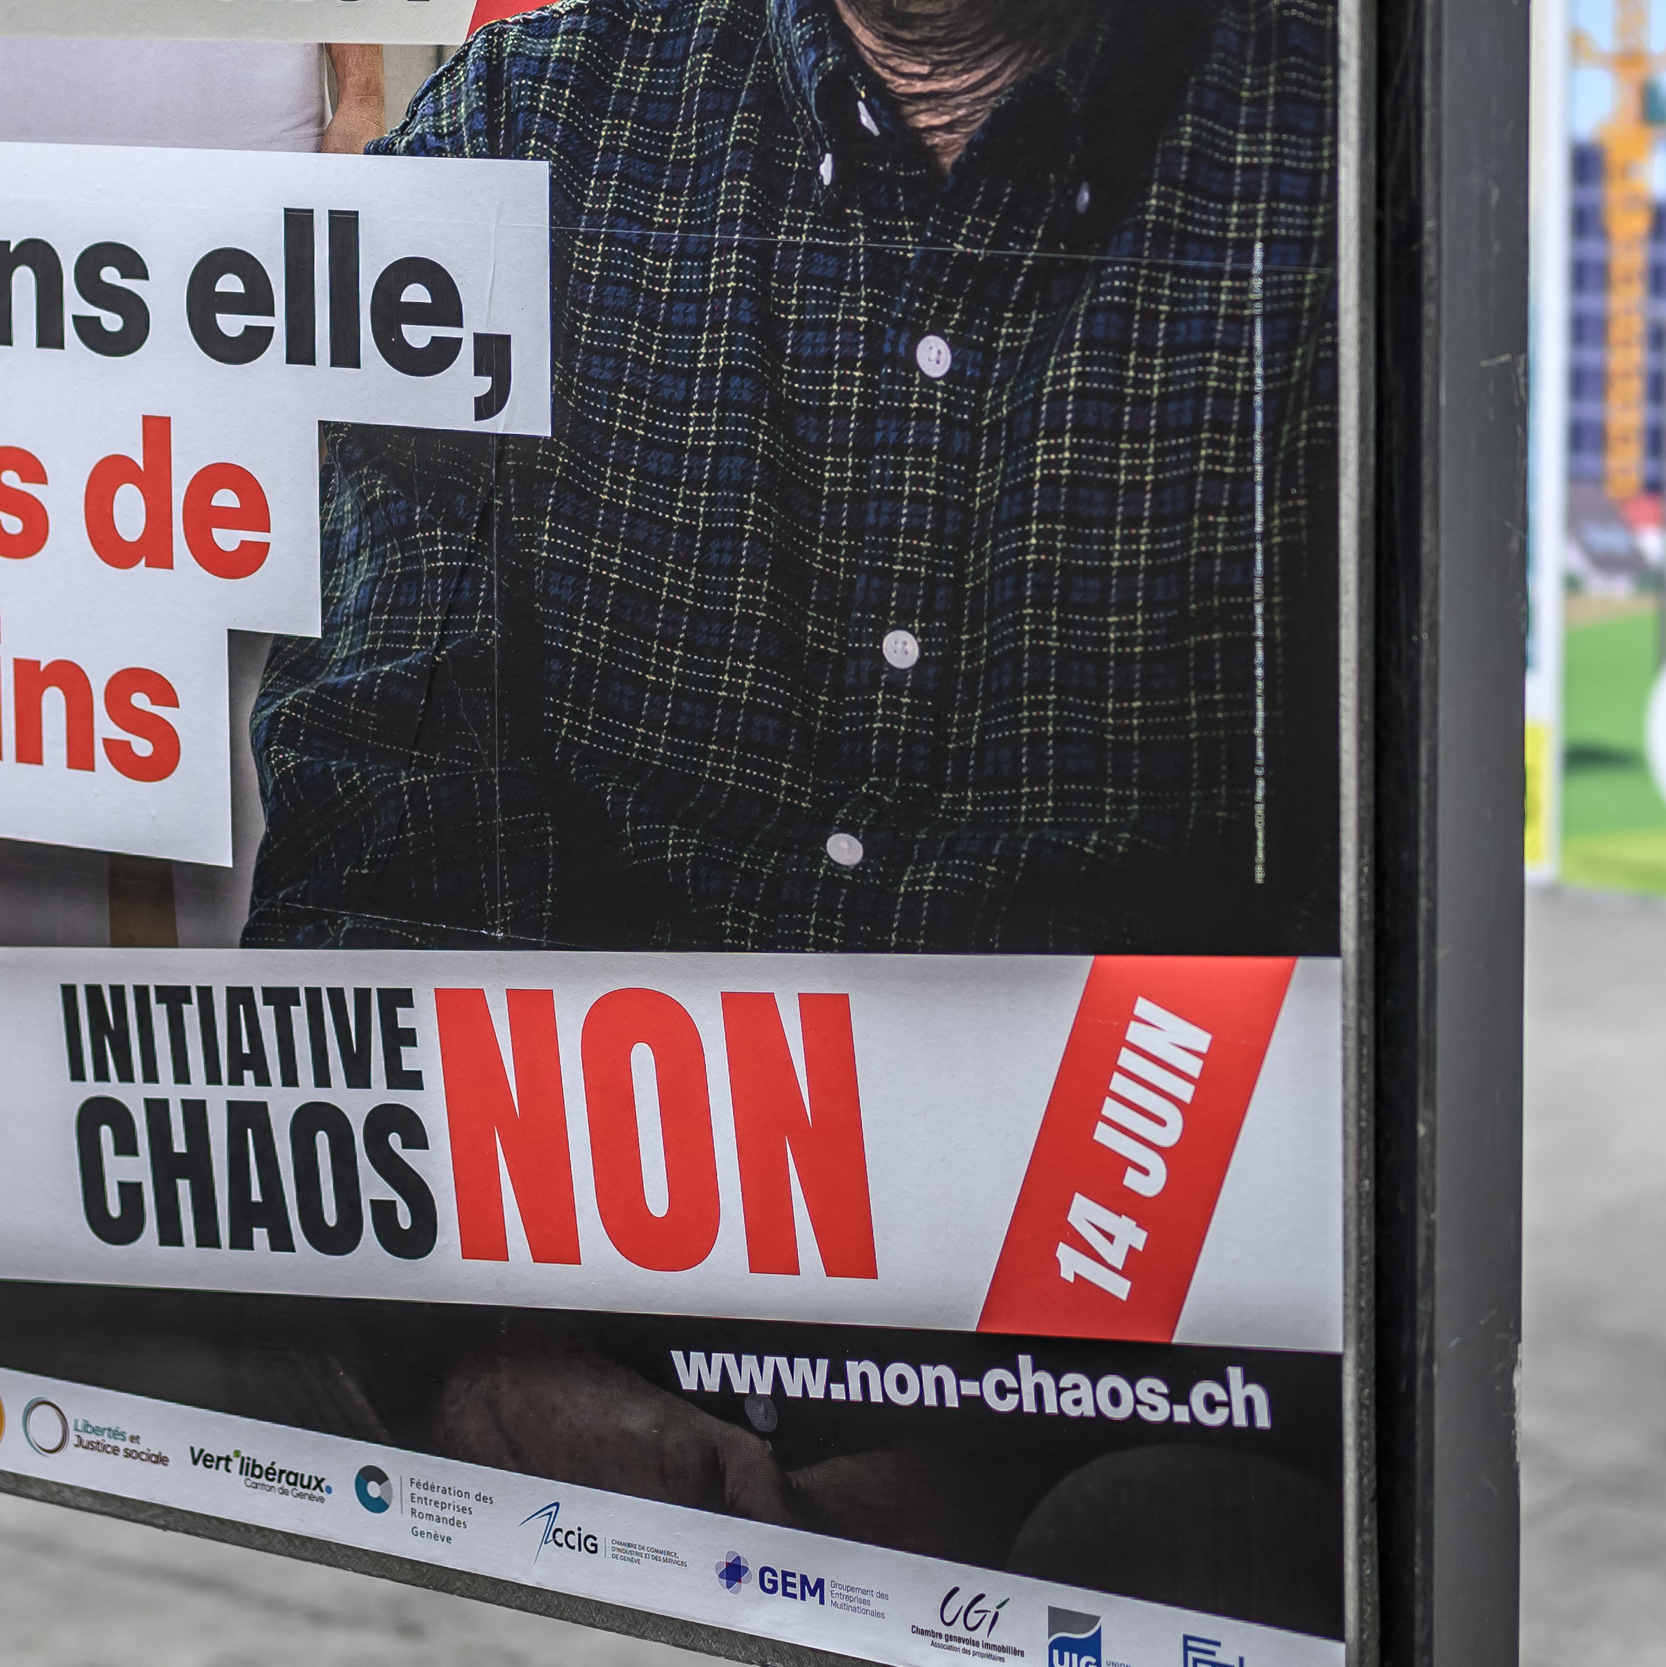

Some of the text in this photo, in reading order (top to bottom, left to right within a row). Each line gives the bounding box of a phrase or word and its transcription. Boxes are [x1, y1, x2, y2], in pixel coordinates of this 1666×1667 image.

[186, 207, 512, 421] elle,
[84, 415, 270, 579] de
[60, 983, 424, 1090] INITIATIVE
[434, 987, 878, 1280] NON
[1055, 996, 1212, 1301] 14 JUIN
[75, 1095, 438, 1261] CHAOS
[670, 1350, 1271, 1429] www.non-chaos.ch
[73, 1418, 140, 1445] Libertés et
[73, 1434, 170, 1467] Justice sociale
[244, 1477, 325, 1504] Canton de Genève
[409, 1477, 494, 1505] Fédération des
[410, 1493, 473, 1515] Entreprises
[410, 1507, 468, 1529] Romandes
[411, 1526, 452, 1544] Genève
[611, 1538, 638, 1550] CHAMBRE
[638, 1544, 645, 1552] DE
[611, 1553, 619, 1561] DE
[651, 1554, 661, 1562] DES
[662, 1556, 688, 1568] SERVICES
[758, 1565, 825, 1606] GEM
[830, 1579, 889, 1600] Groupement des
[830, 1590, 871, 1607] Entreprises
[830, 1600, 885, 1620] Multinationales
[911, 1624, 943, 1640] Chambre
[944, 1633, 980, 1648] genevoise
[930, 1639, 1006, 1663] Association des propriétaires
